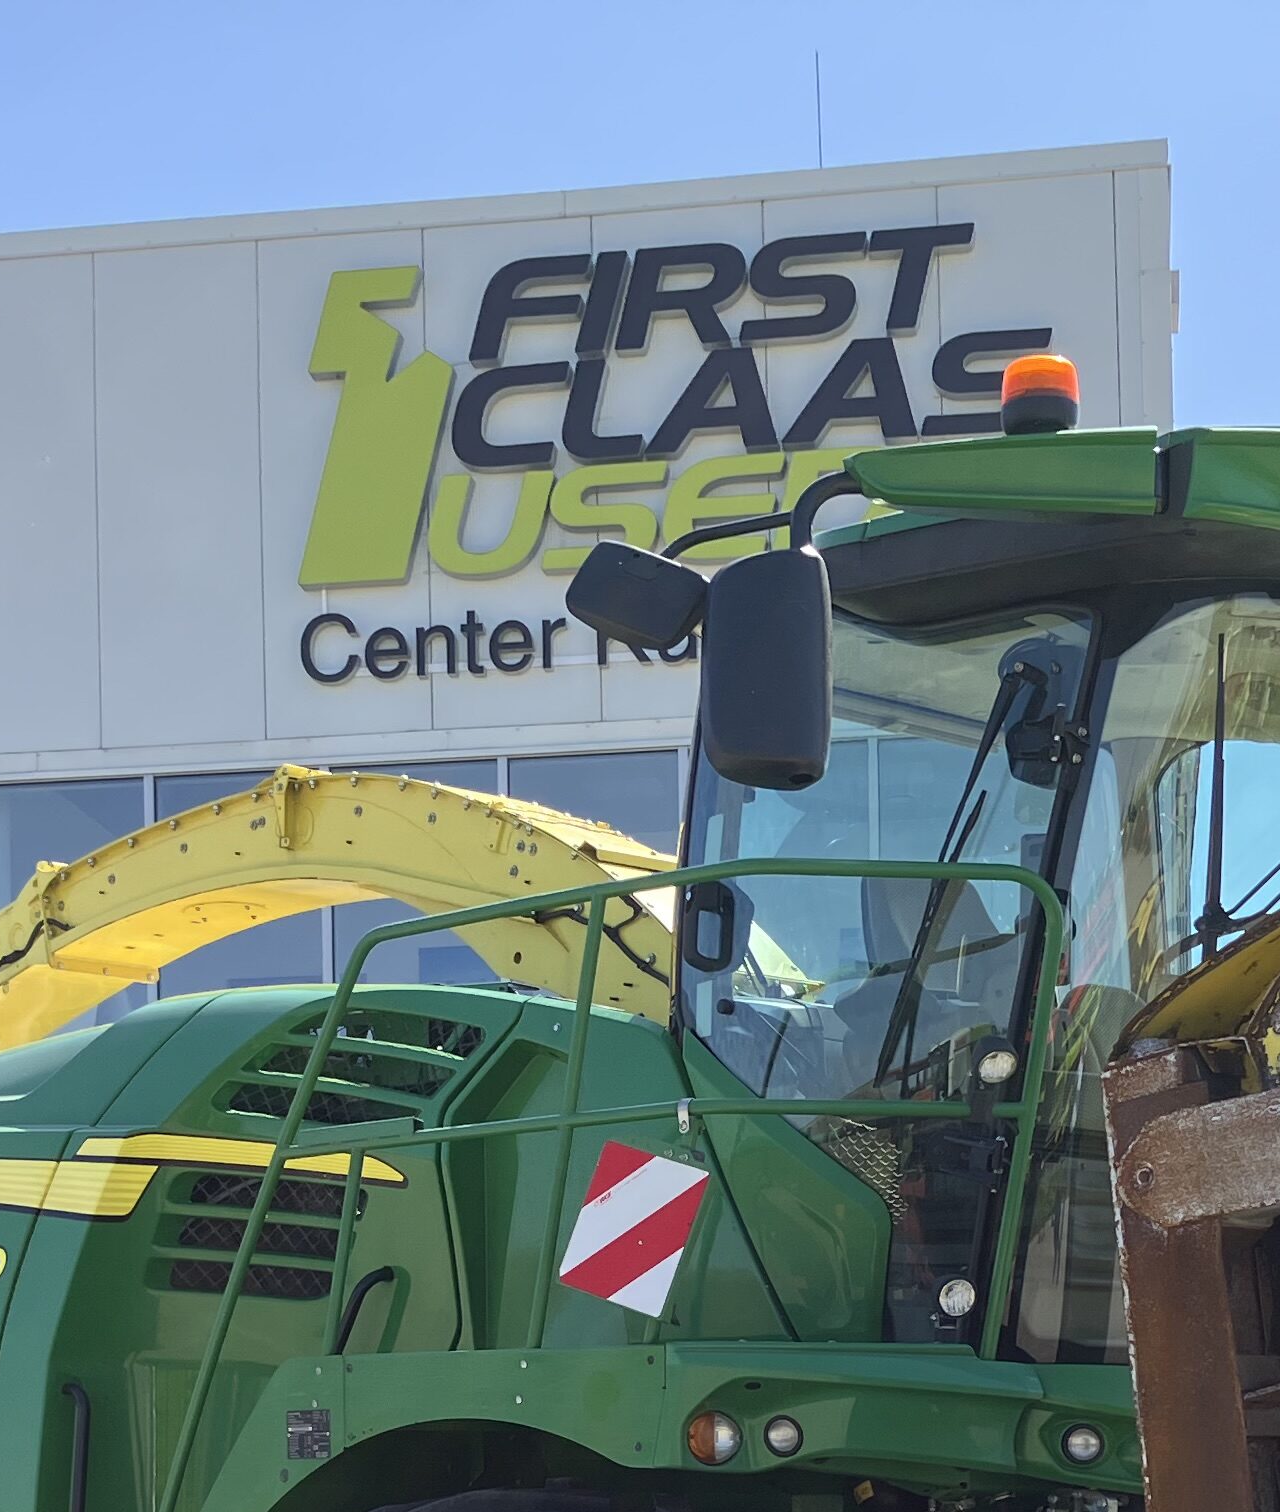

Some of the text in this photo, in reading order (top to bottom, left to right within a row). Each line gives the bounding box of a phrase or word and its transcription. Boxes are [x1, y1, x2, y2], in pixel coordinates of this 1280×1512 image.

[468, 222, 976, 370] FIRST
[451, 327, 1053, 474] CLAAS
[300, 610, 568, 685] Center
